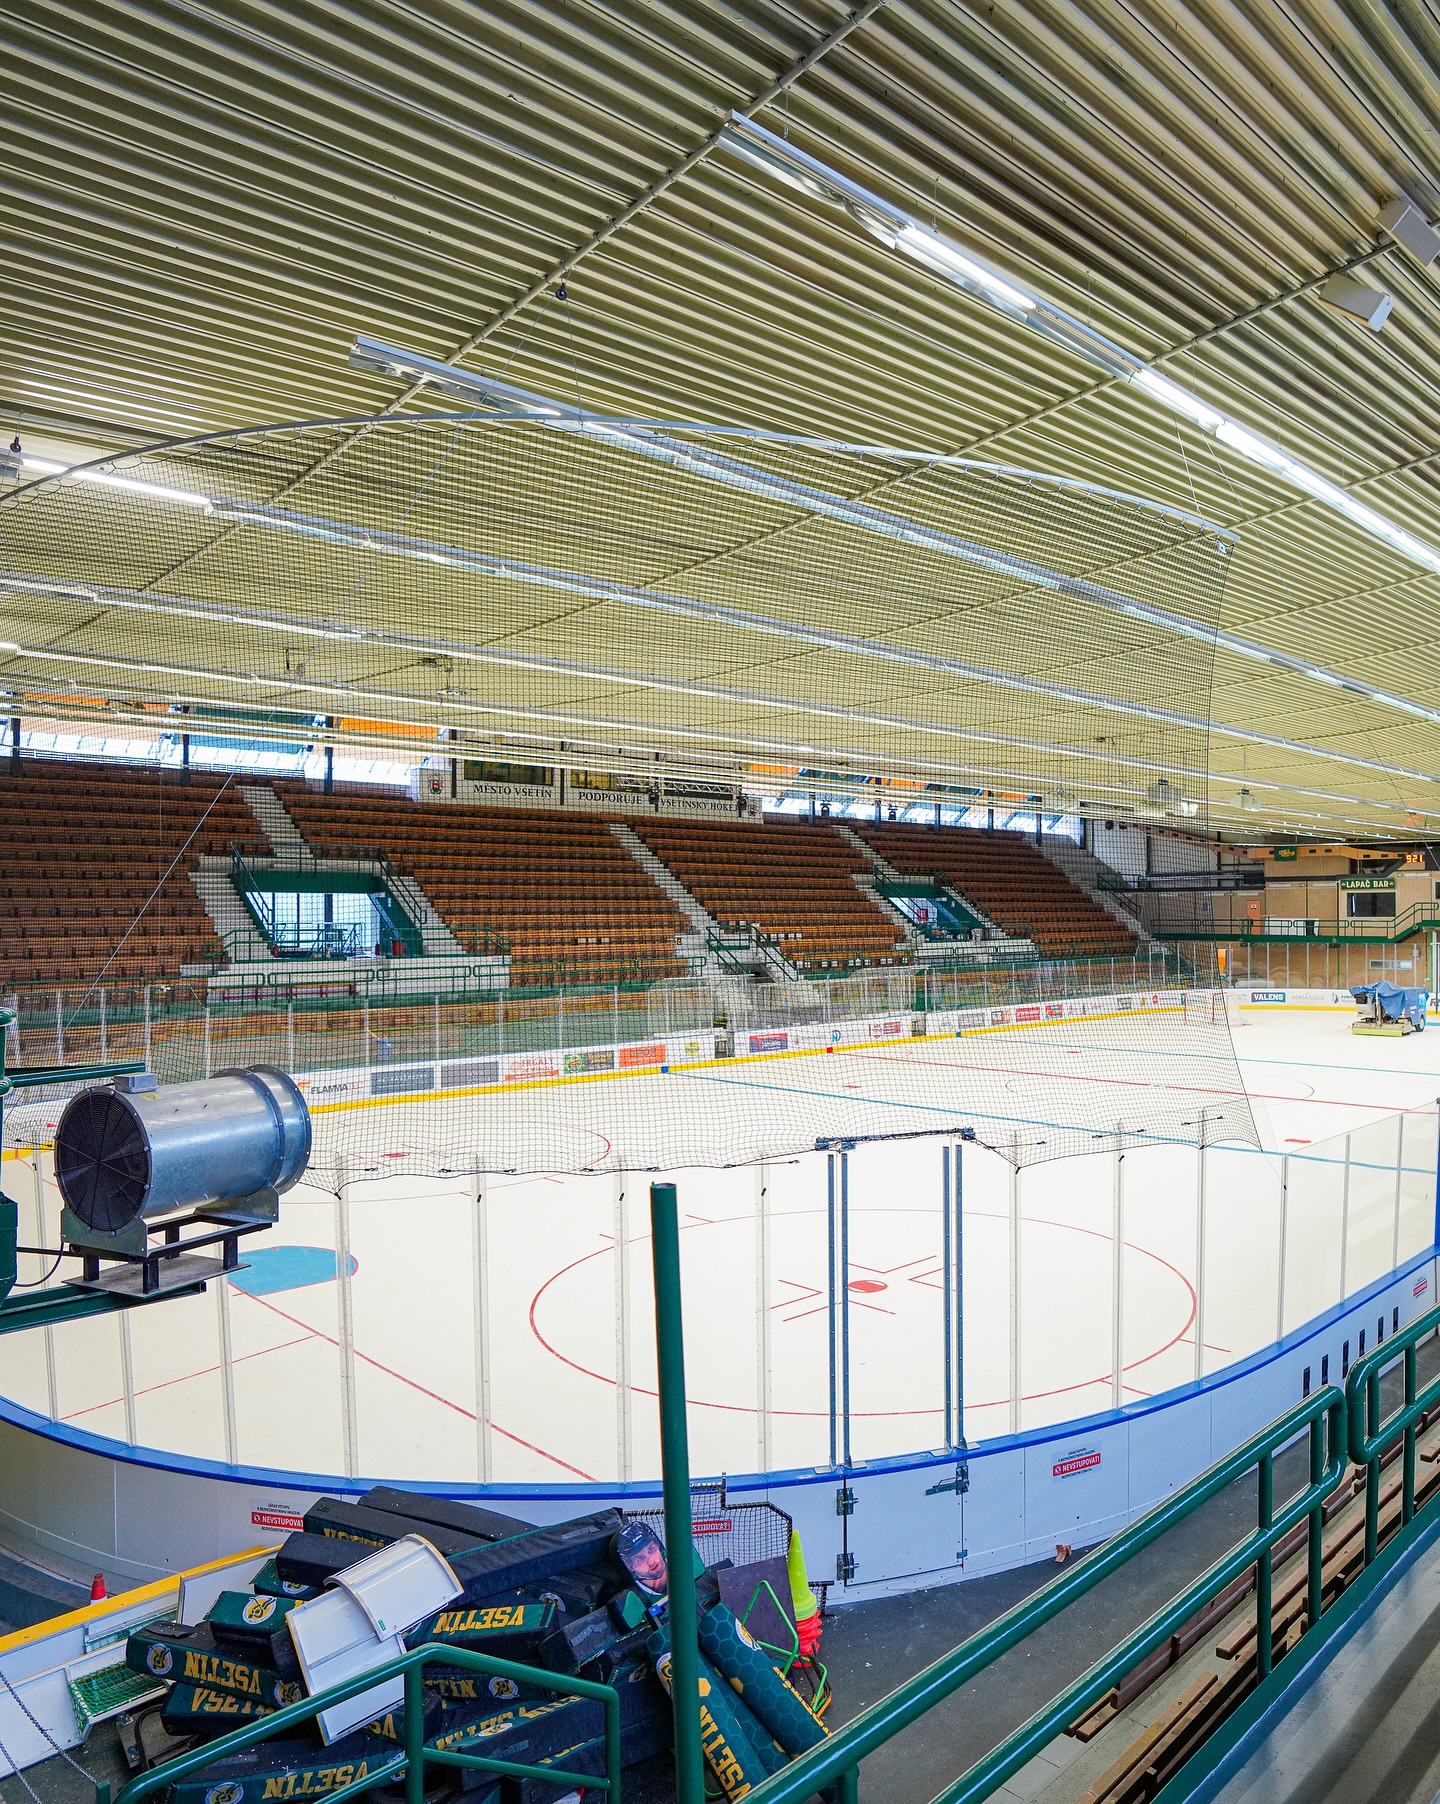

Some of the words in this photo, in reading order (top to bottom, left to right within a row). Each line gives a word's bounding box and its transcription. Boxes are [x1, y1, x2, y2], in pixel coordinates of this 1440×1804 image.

[473, 783, 511, 796] MĚSTO
[514, 786, 552, 798] VSETÍN
[578, 791, 643, 805] PODPORUJE
[1346, 879, 1371, 888] LAPAČ
[1373, 880, 1389, 888] BAR
[1253, 993, 1284, 1001] VALENS
[432, 1605, 525, 1636] VSETÍN
[183, 1650, 263, 1696] VSETÍN
